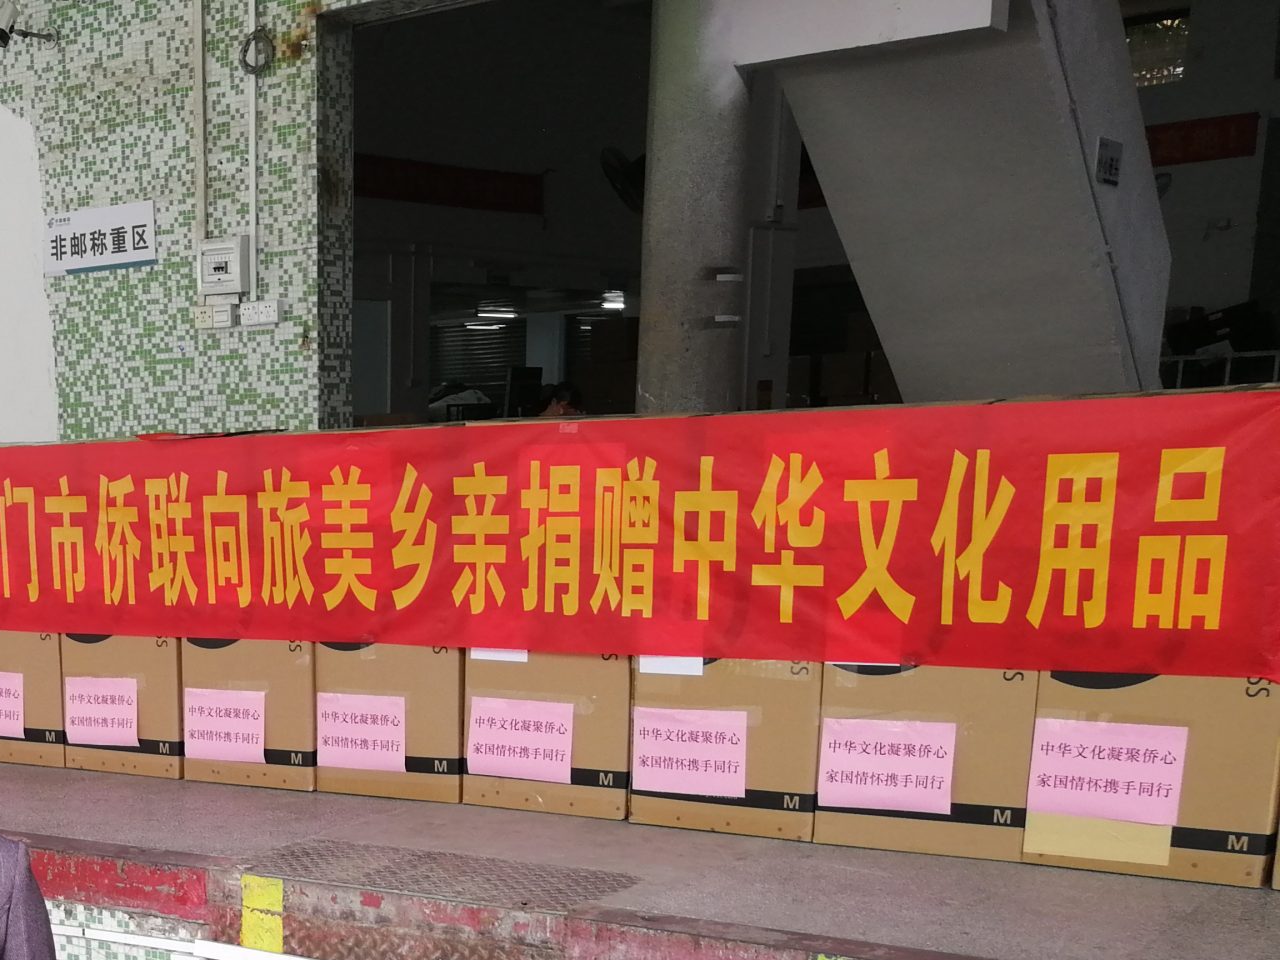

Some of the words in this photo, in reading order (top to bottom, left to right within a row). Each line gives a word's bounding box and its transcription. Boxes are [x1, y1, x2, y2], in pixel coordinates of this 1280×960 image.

[50, 223, 149, 261] 非邮称重区
[69, 692, 134, 707] 中华文化凝聚侨心
[188, 705, 261, 721] 中华文化凝聚侨心
[321, 710, 401, 728] 中华文化凝聚侨心
[69, 715, 134, 729] 家国情怀携手同行
[474, 716, 568, 735] 中华文化凝聚侨心
[45, 730, 56, 742] M
[188, 730, 260, 745] 家国情怀携手同行
[321, 735, 401, 752] 家国情怀携手同行
[638, 726, 741, 746] 中华文化凝聚侨心
[159, 742, 170, 755] M
[473, 742, 566, 762] 家国情怀携手同行
[828, 739, 948, 759] 中华文化凝聚侨心
[1040, 742, 1177, 765] 中华文化凝聚侨心
[290, 752, 303, 765] M
[434, 759, 448, 773] M
[638, 754, 740, 774] 家国情怀携手同行
[599, 772, 614, 786] M
[825, 769, 945, 791] 家国情怀携手同行
[1036, 773, 1174, 798] 家国情怀携手同行
[783, 795, 800, 810] M
[993, 808, 1012, 825] M
[1227, 834, 1249, 851] M
